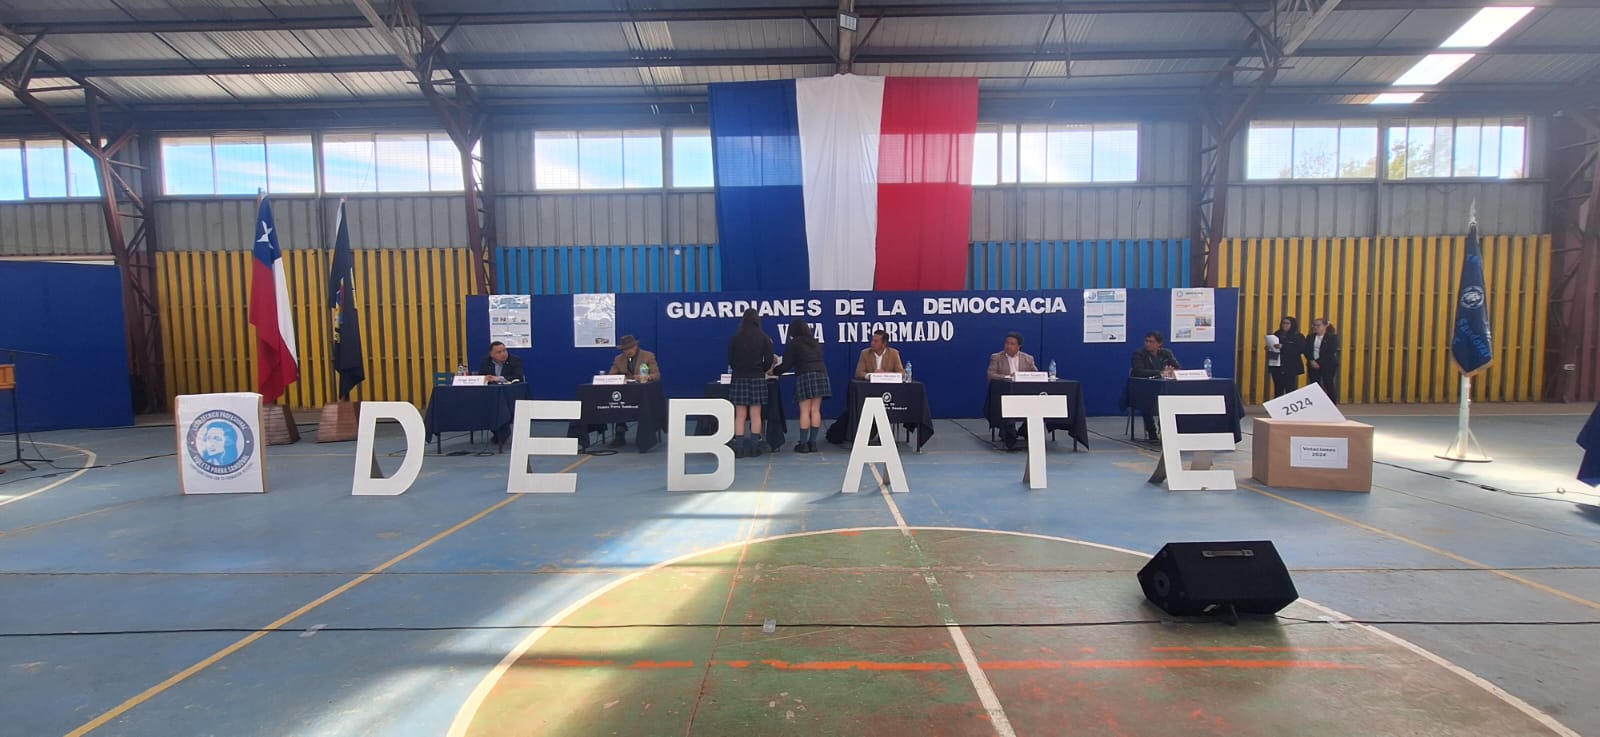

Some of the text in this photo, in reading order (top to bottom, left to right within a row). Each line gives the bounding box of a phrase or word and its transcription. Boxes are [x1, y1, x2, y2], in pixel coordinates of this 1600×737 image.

[666, 297, 1067, 319] GUARDIANES DE LA DEMOCRACIA
[1282, 397, 1313, 416] 2024
[352, 395, 1236, 495] DEBATE
